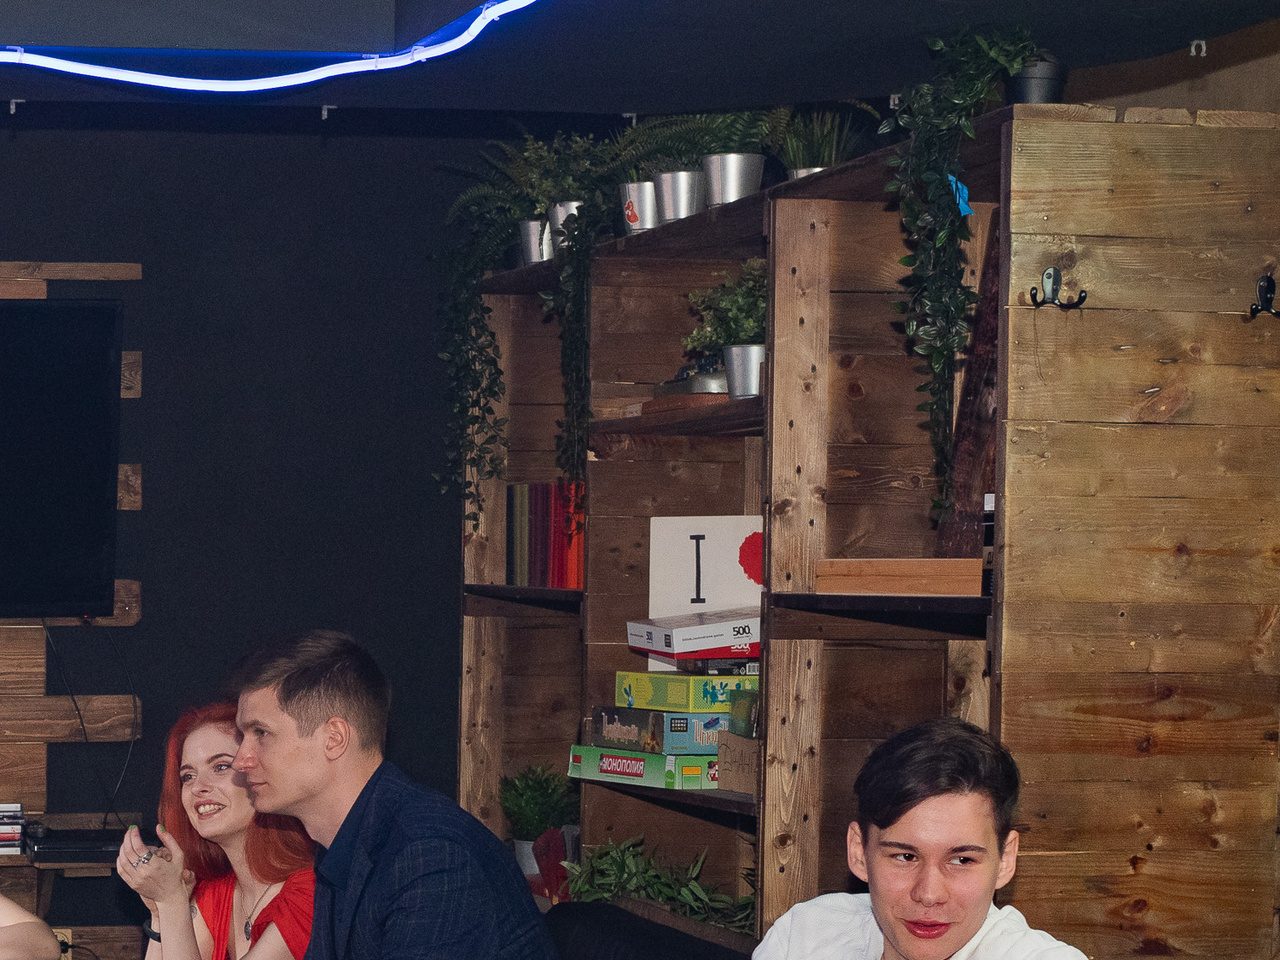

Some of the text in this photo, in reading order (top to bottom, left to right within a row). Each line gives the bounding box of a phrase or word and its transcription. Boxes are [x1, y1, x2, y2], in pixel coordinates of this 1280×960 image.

[689, 534, 706, 604] I
[732, 625, 751, 637] 500
[601, 757, 645, 775] МОНОПОЛИЯ
